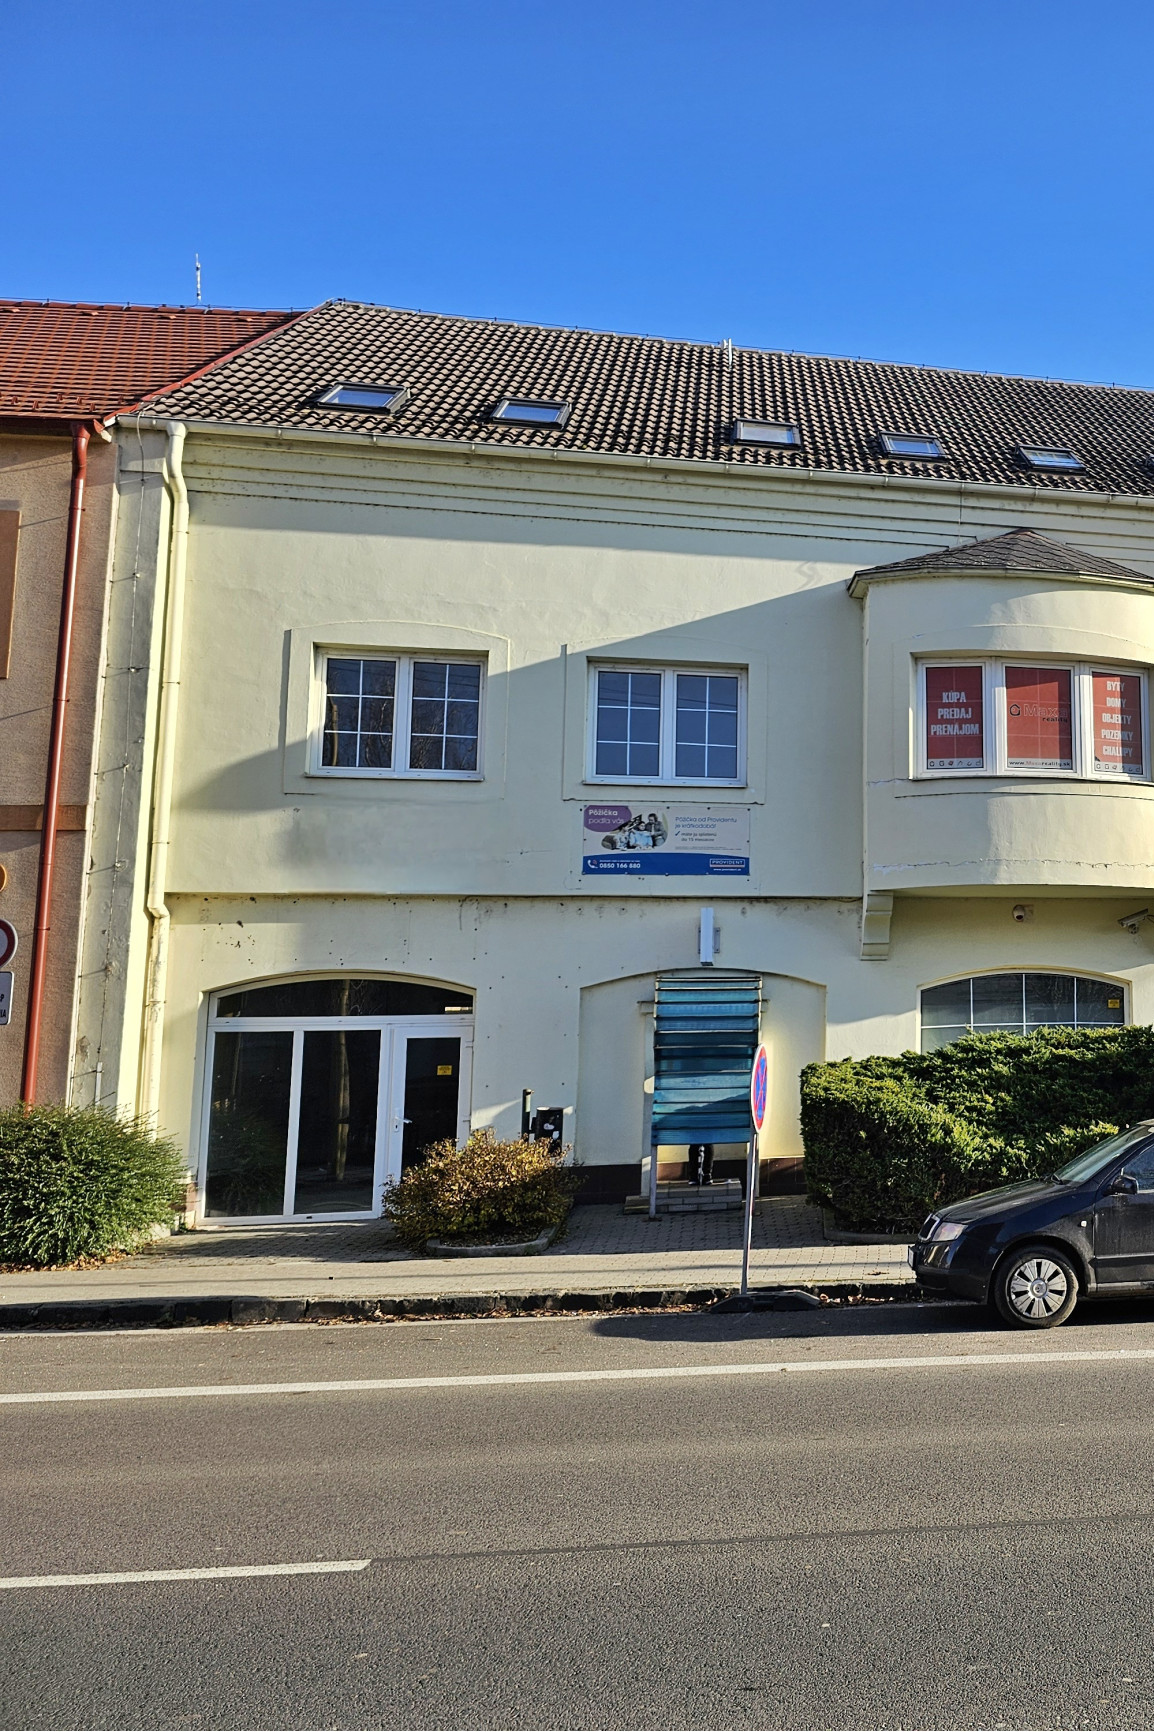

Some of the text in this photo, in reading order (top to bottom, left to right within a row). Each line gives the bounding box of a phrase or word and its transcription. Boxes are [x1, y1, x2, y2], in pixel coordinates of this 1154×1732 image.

[1106, 681, 1125, 692] BYTY
[942, 690, 967, 703] KÚPA
[1106, 697, 1127, 708] DOMY
[937, 707, 972, 719] PREDAJ
[1102, 713, 1132, 725] OBJEKTY
[930, 722, 980, 736] PRENÁJOM
[1101, 729, 1133, 742] POZEMKY
[588, 808, 618, 816] Pôžička
